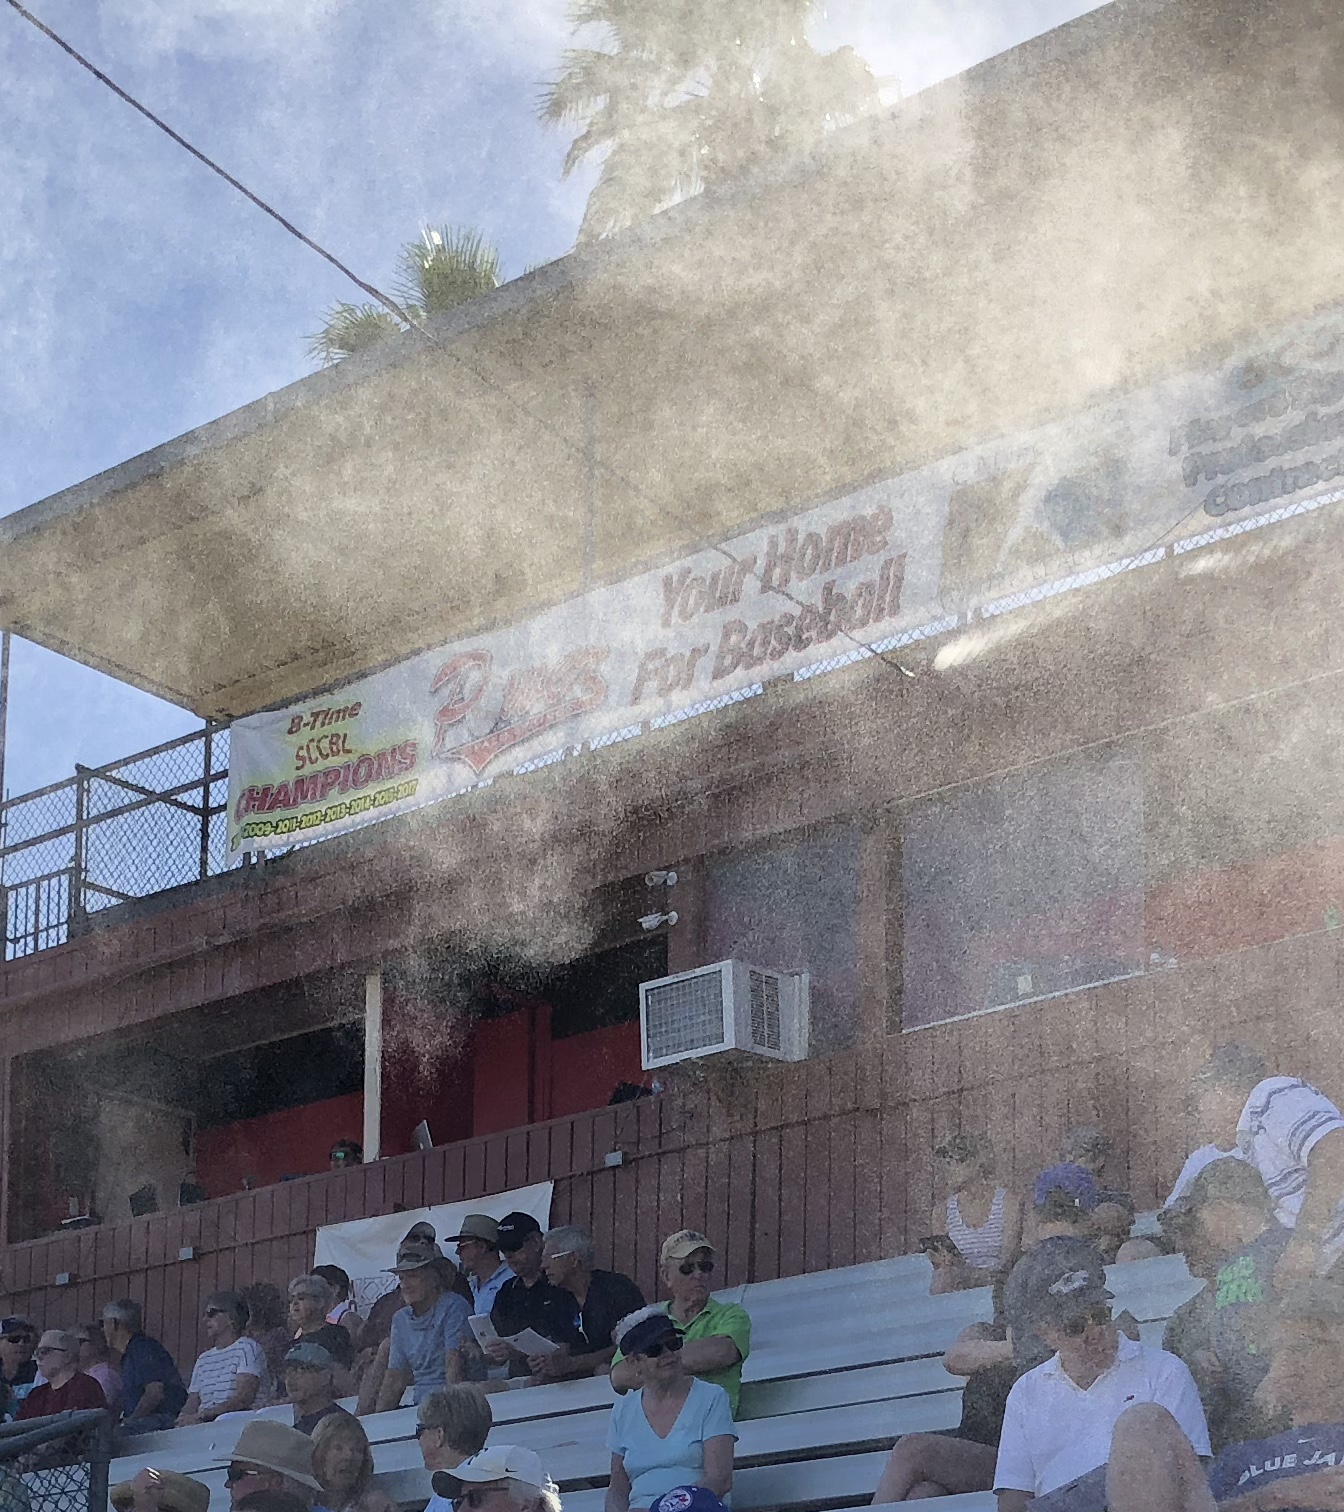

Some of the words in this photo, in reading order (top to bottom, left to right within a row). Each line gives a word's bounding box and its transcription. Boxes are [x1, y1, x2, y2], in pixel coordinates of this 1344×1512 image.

[661, 555, 757, 629] Your
[760, 505, 894, 594] Home
[631, 642, 710, 706] For
[712, 551, 908, 681] Baseball
[234, 739, 418, 825] CHAMPIONS
[295, 732, 353, 770] SCCBL
